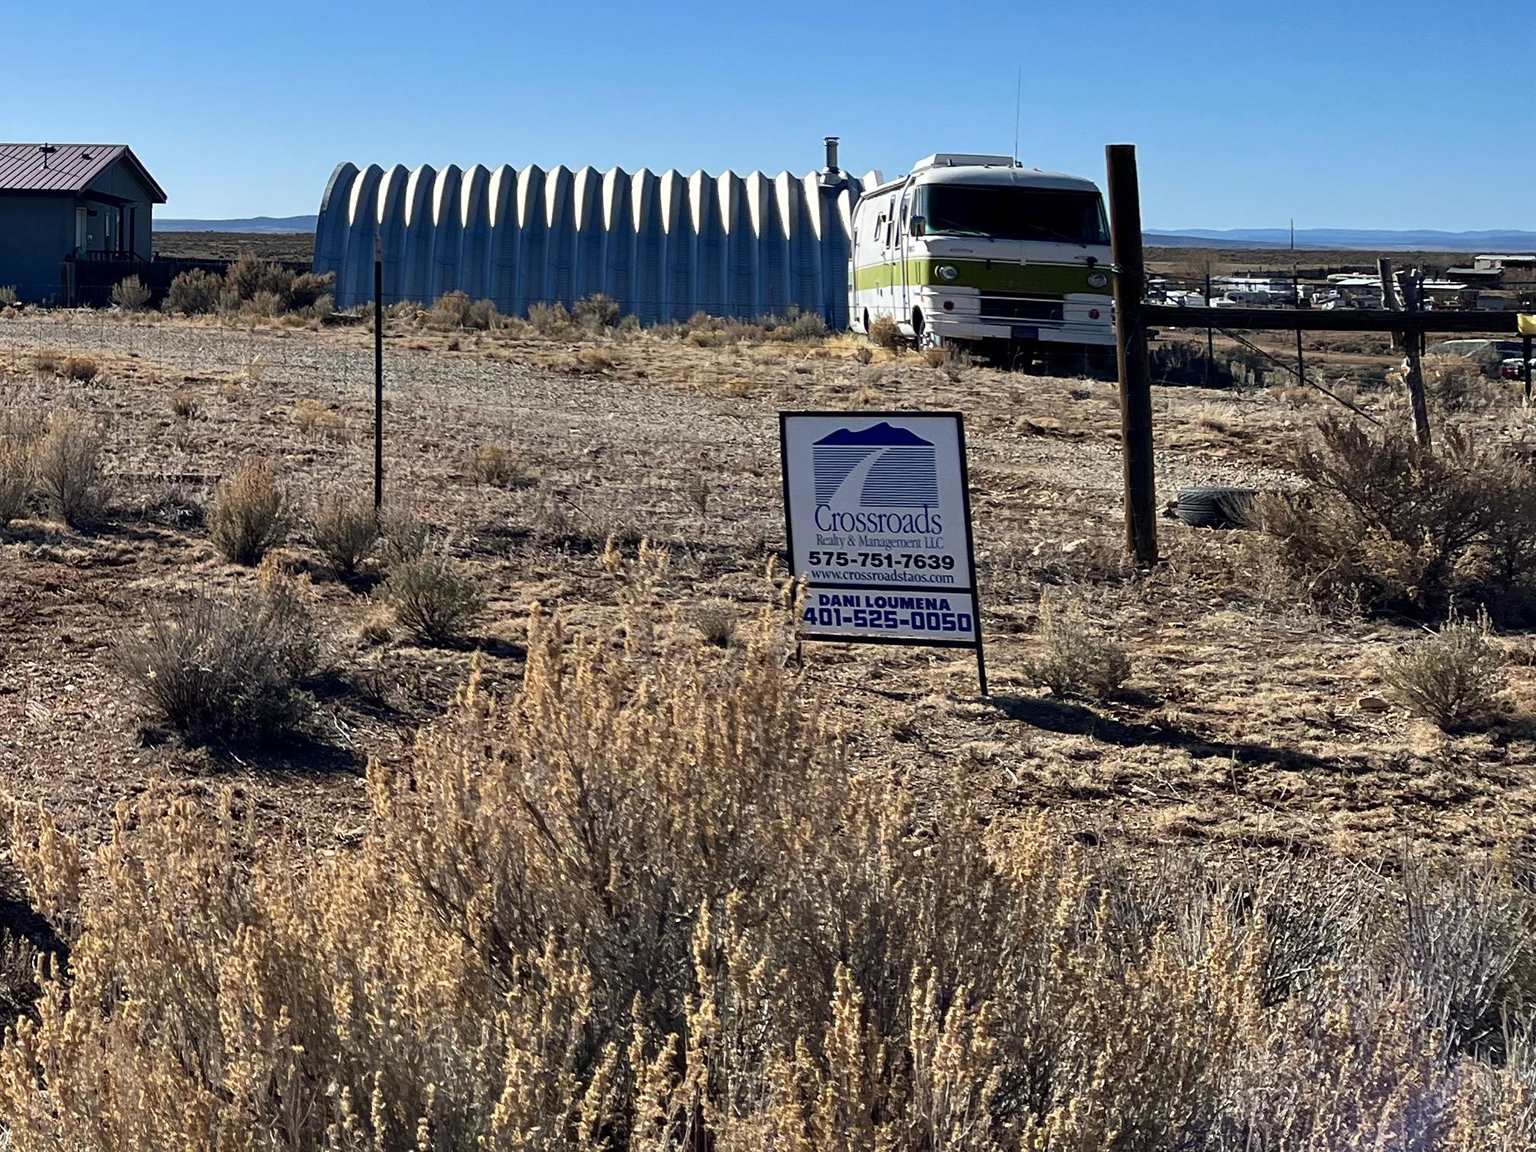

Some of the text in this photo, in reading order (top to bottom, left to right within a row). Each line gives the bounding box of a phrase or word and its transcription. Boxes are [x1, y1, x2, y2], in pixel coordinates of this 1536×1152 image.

[815, 504, 943, 534] Crossroads
[816, 534, 944, 550] Realty & Management LLC
[808, 551, 955, 570] 575-751-7639
[811, 569, 954, 583] www.crossroadstaos.com
[819, 594, 951, 611] DANI LOUMENA
[803, 608, 972, 632] 401-525-0050
